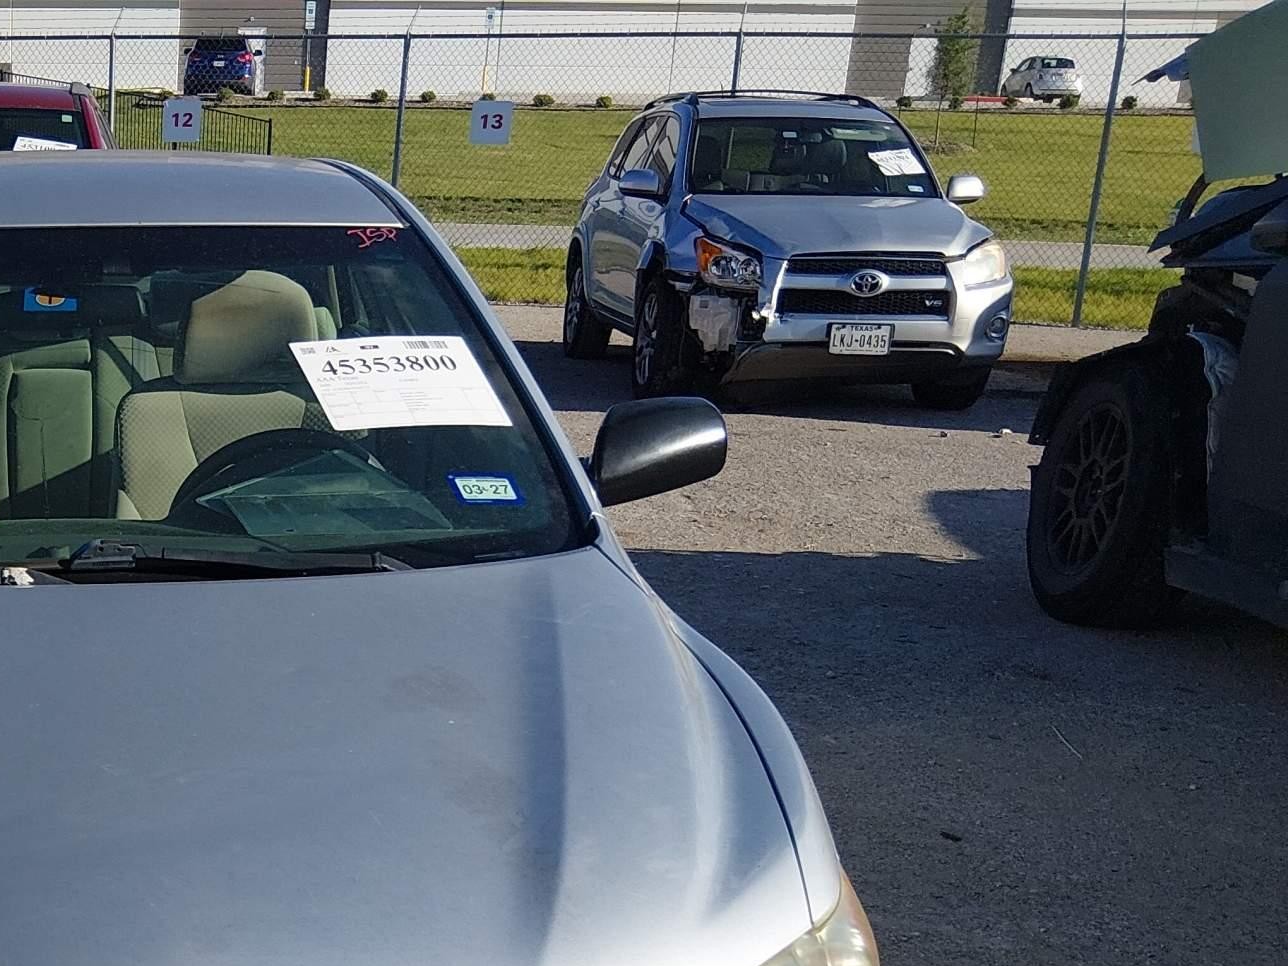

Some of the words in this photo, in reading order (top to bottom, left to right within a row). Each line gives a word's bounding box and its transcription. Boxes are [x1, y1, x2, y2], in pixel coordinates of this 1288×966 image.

[171, 112, 193, 128] 12
[480, 113, 504, 130] 13
[924, 299, 943, 307] V6
[831, 333, 888, 349] LKJ-0435
[321, 355, 457, 376] 45353800
[462, 484, 484, 495] 03
[489, 484, 509, 495] 27
